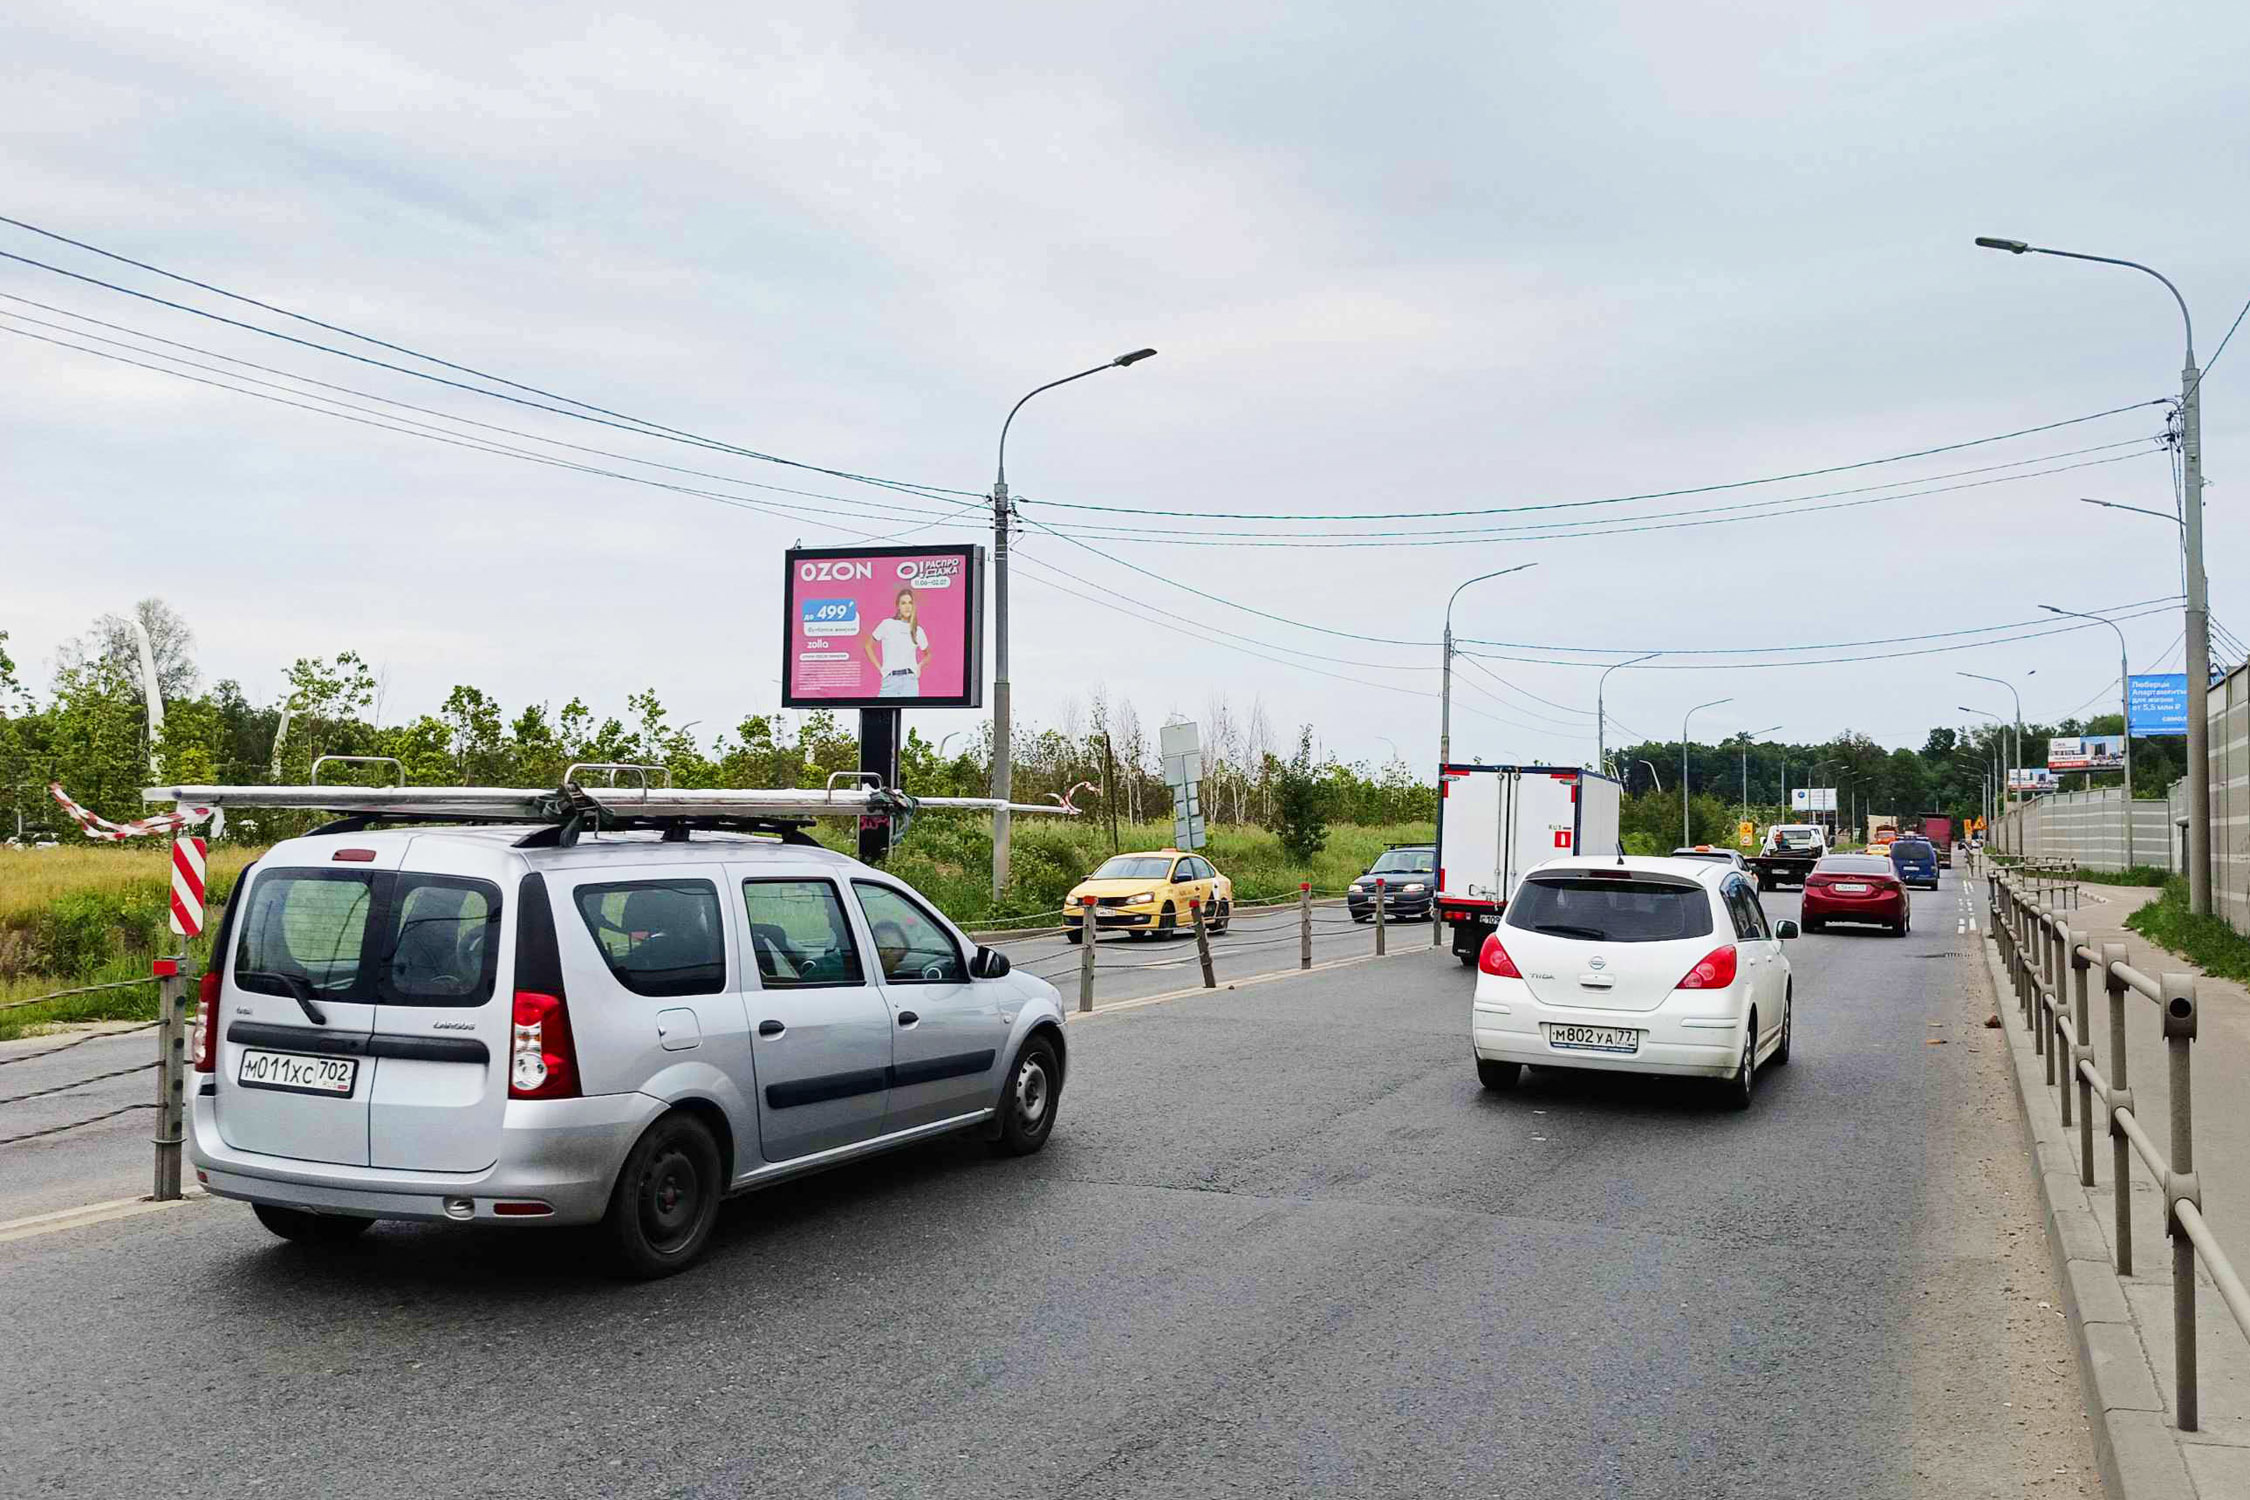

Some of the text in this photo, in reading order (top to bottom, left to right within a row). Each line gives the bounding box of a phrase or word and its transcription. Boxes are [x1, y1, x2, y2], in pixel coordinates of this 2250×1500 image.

[801, 562, 872, 582] OZON
[817, 605, 847, 620] 499
[1555, 1027, 1633, 1045] М802УА 77
[245, 1056, 349, 1085] М011ХС 702
